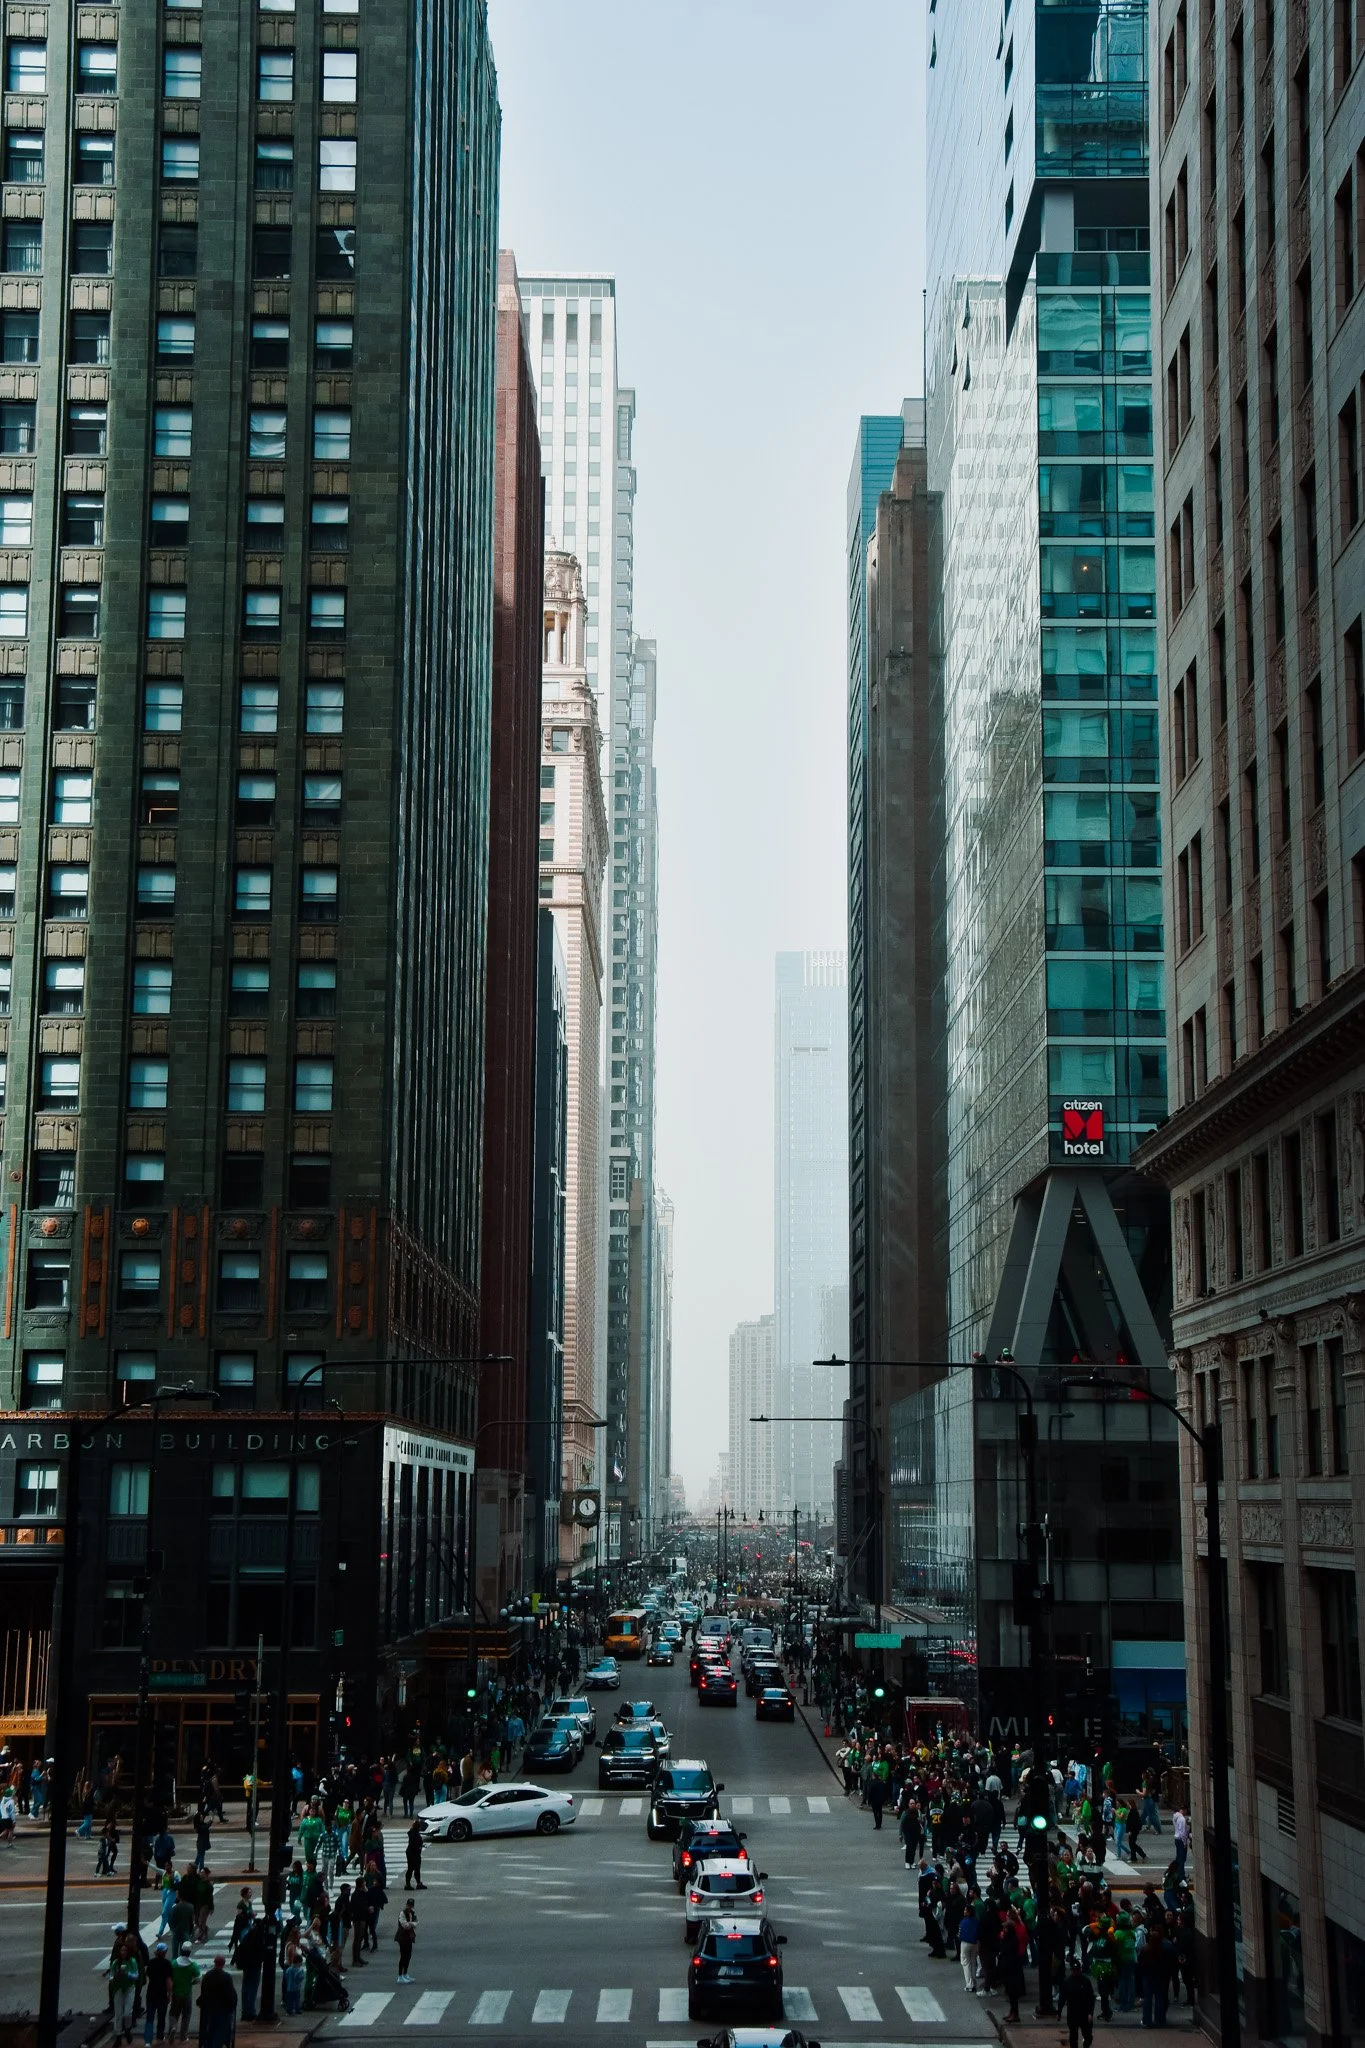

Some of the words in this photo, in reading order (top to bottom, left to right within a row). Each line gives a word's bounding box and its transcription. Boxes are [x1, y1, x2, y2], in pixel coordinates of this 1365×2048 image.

[1063, 1099, 1103, 1111] citizen
[1064, 1140, 1104, 1155] hotel
[160, 1434, 330, 1451] BUILDING
